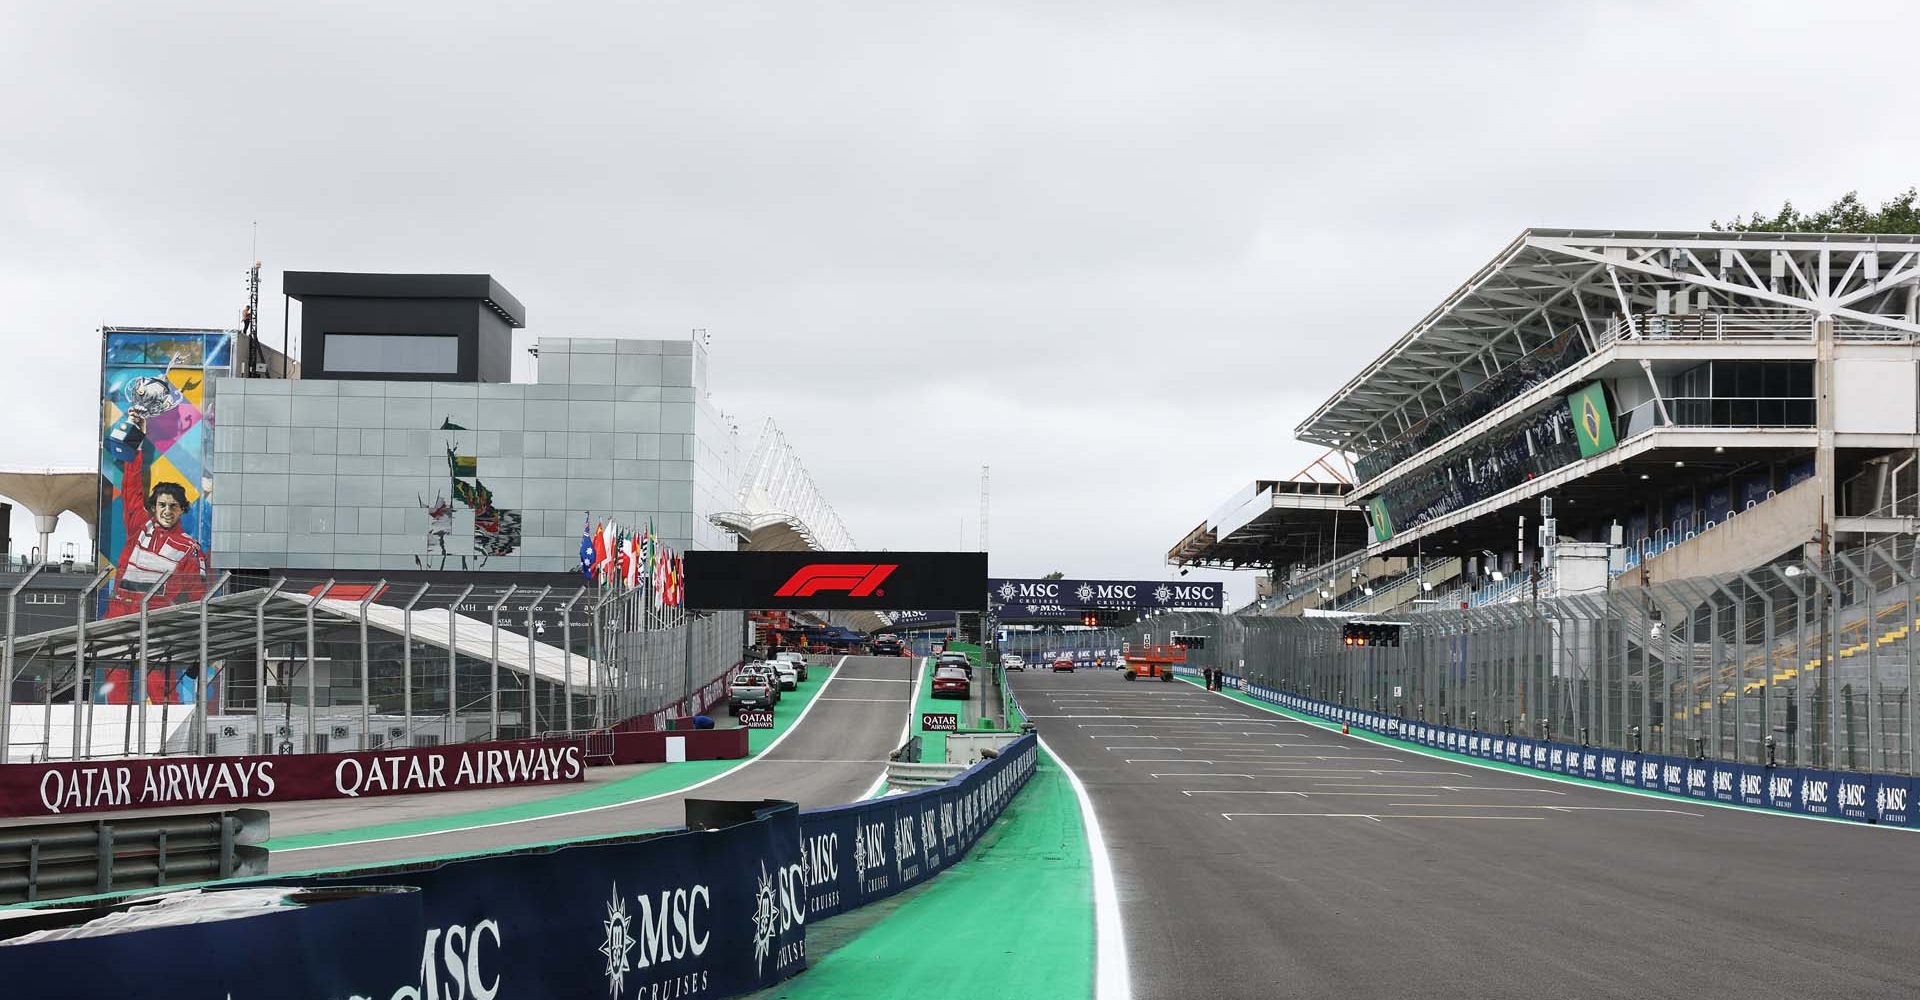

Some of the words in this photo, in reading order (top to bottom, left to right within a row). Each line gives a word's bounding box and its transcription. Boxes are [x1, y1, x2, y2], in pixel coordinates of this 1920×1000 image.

[1019, 583, 1059, 598] MSC
[1097, 584, 1137, 599] MSC
[1174, 586, 1214, 600] MSC
[901, 610, 927, 618] MSC
[1040, 604, 1066, 612] MSC
[740, 713, 773, 724] QATAR
[923, 715, 956, 726] QATAR
[334, 754, 447, 797] QATAR
[454, 746, 581, 785] AIRWAYS
[40, 767, 131, 814] QATAR
[140, 761, 275, 803] AIRWAYS
[1776, 777, 1793, 798] MSC
[1809, 780, 1828, 803] MSC
[1846, 783, 1866, 807] MSC
[1886, 787, 1907, 811] MSC
[866, 821, 886, 869] MSC
[900, 815, 916, 859] MSC
[809, 832, 839, 886] MSC
[868, 875, 889, 893] CRUISES
[811, 890, 840, 913] CRUISES
[638, 884, 710, 969] MSC
[638, 970, 708, 1000] CRUISES
